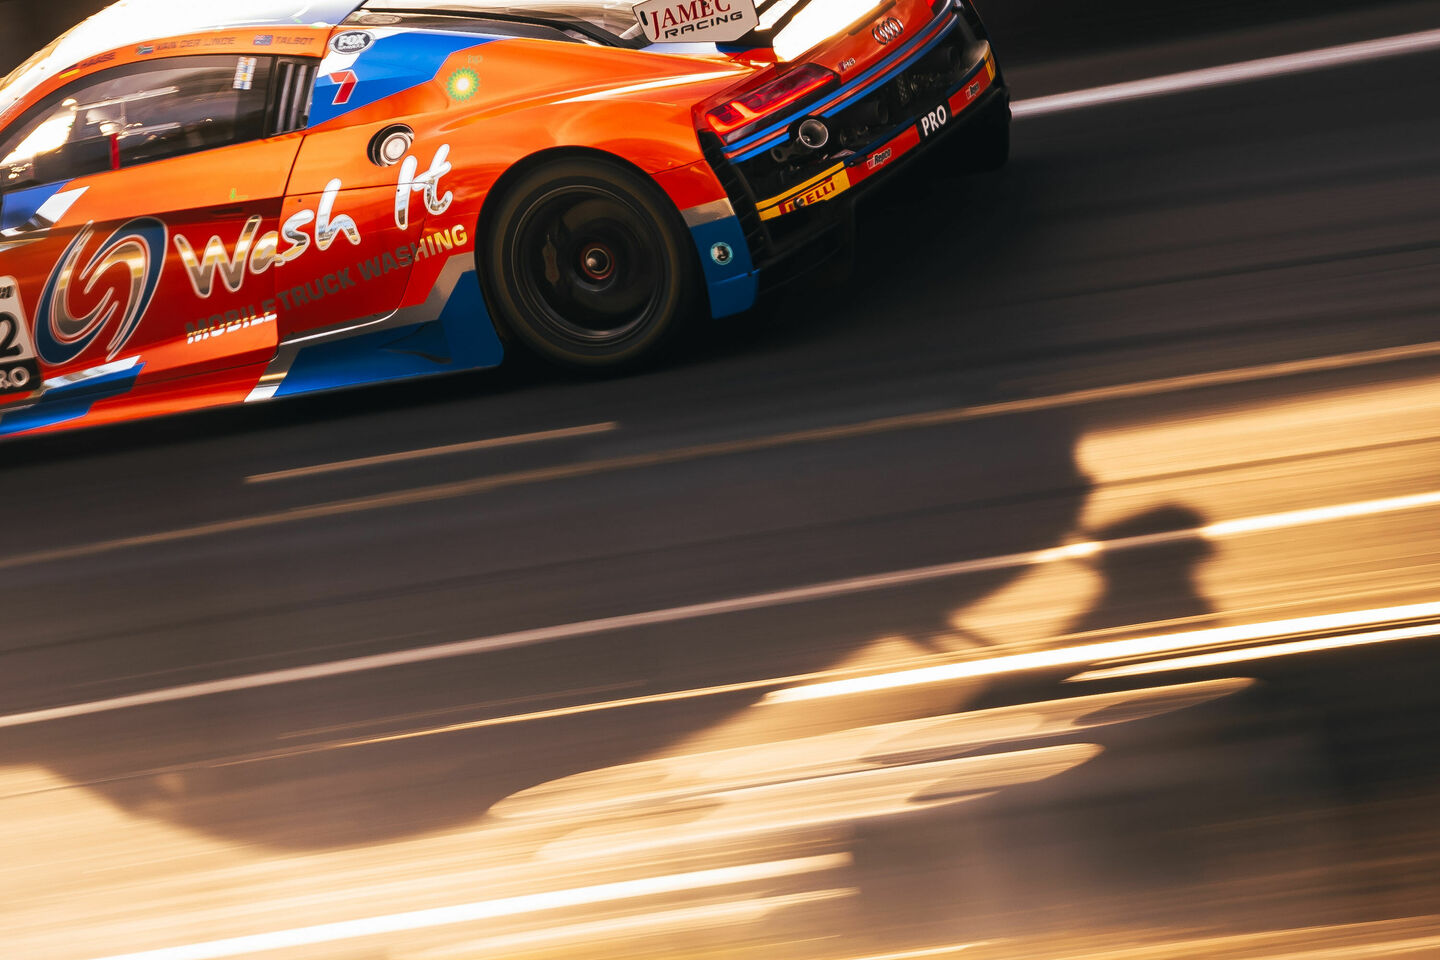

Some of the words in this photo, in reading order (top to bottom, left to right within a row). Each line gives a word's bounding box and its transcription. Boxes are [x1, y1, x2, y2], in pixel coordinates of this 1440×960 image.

[664, 11, 743, 39] RACING
[920, 104, 947, 137] PRO
[778, 176, 835, 215] PIELLI
[173, 178, 361, 298] Wash
[394, 143, 453, 230] It
[185, 302, 277, 344] MOBILE
[276, 267, 357, 312] TRUCK
[357, 224, 468, 282] WASHING
